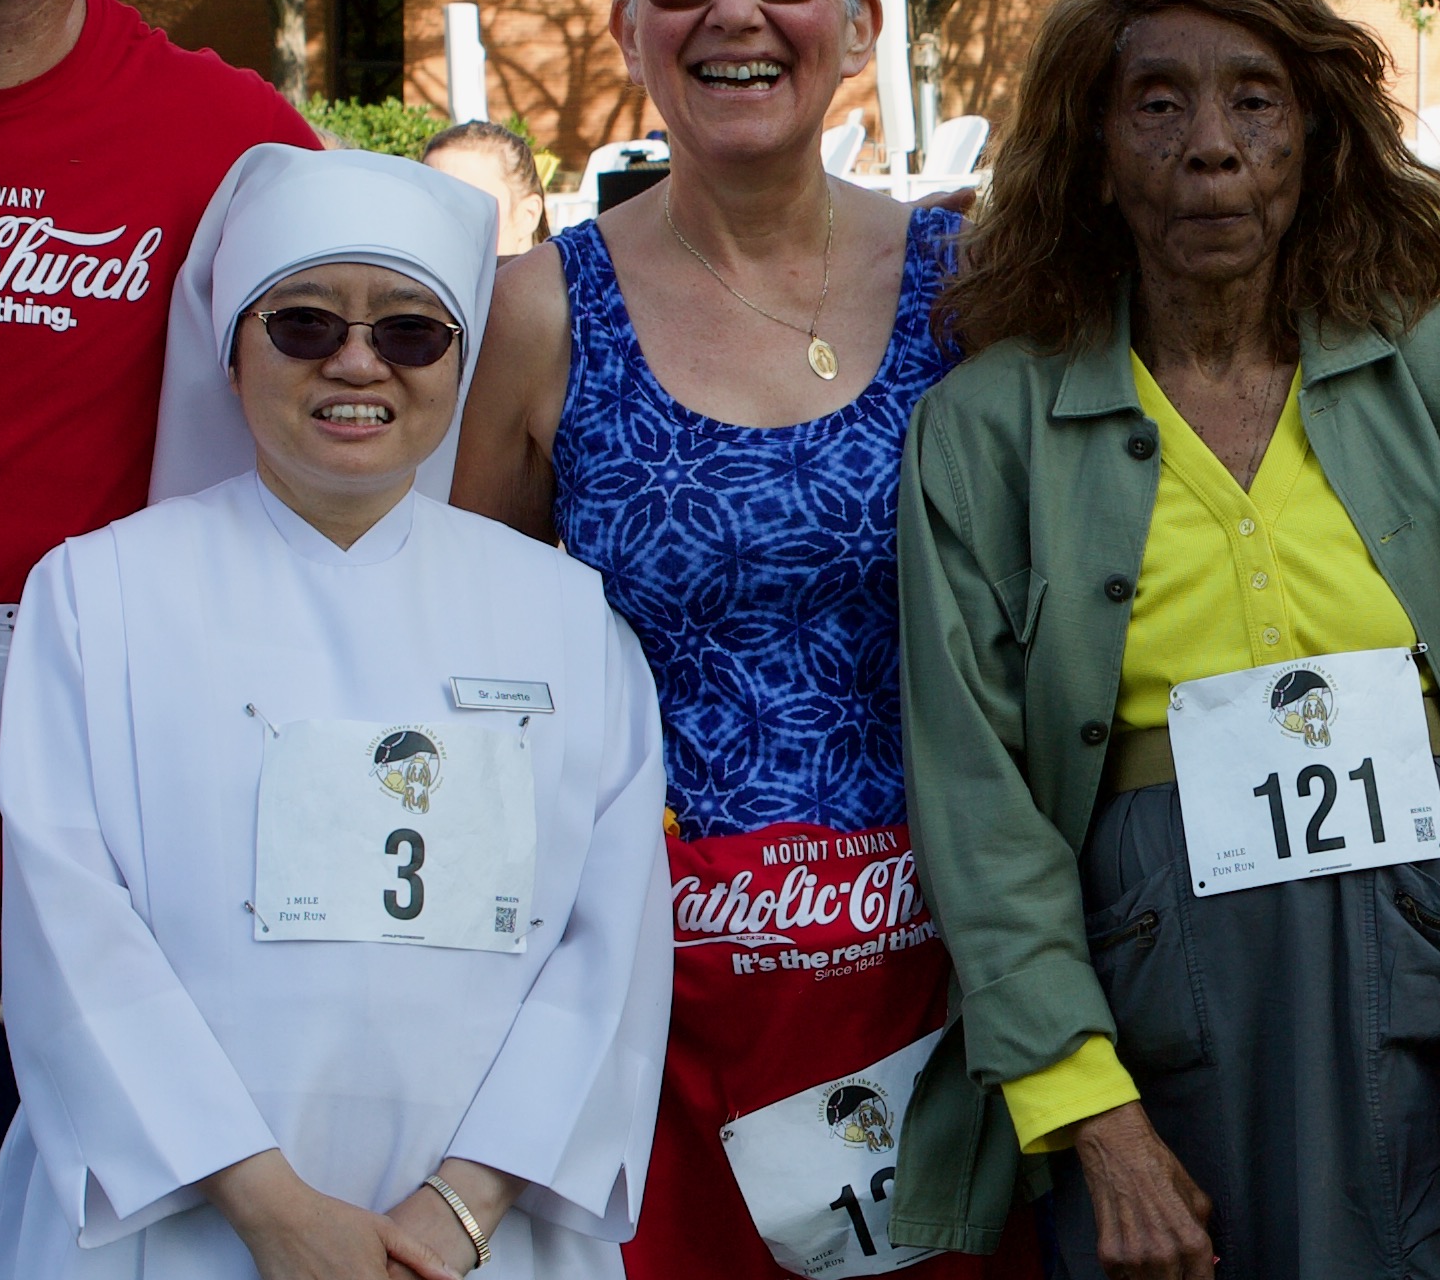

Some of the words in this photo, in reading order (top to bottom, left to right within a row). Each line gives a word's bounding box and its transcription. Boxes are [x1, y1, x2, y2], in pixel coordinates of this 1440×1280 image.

[1253, 757, 1386, 860] 121
[762, 840, 828, 866] MOUNT
[836, 831, 898, 859] CALVARY
[1222, 847, 1246, 859] MILE
[383, 828, 425, 920] 3
[1212, 865, 1233, 877] FUN
[1234, 861, 1255, 873] RUN
[294, 896, 319, 905] MILE
[279, 912, 300, 921] FUN
[304, 912, 326, 921] RUN
[732, 952, 777, 974] It's
[779, 949, 830, 969] the
[832, 933, 886, 965] real
[814, 966, 852, 982] Since
[824, 1257, 845, 1269] RUN
